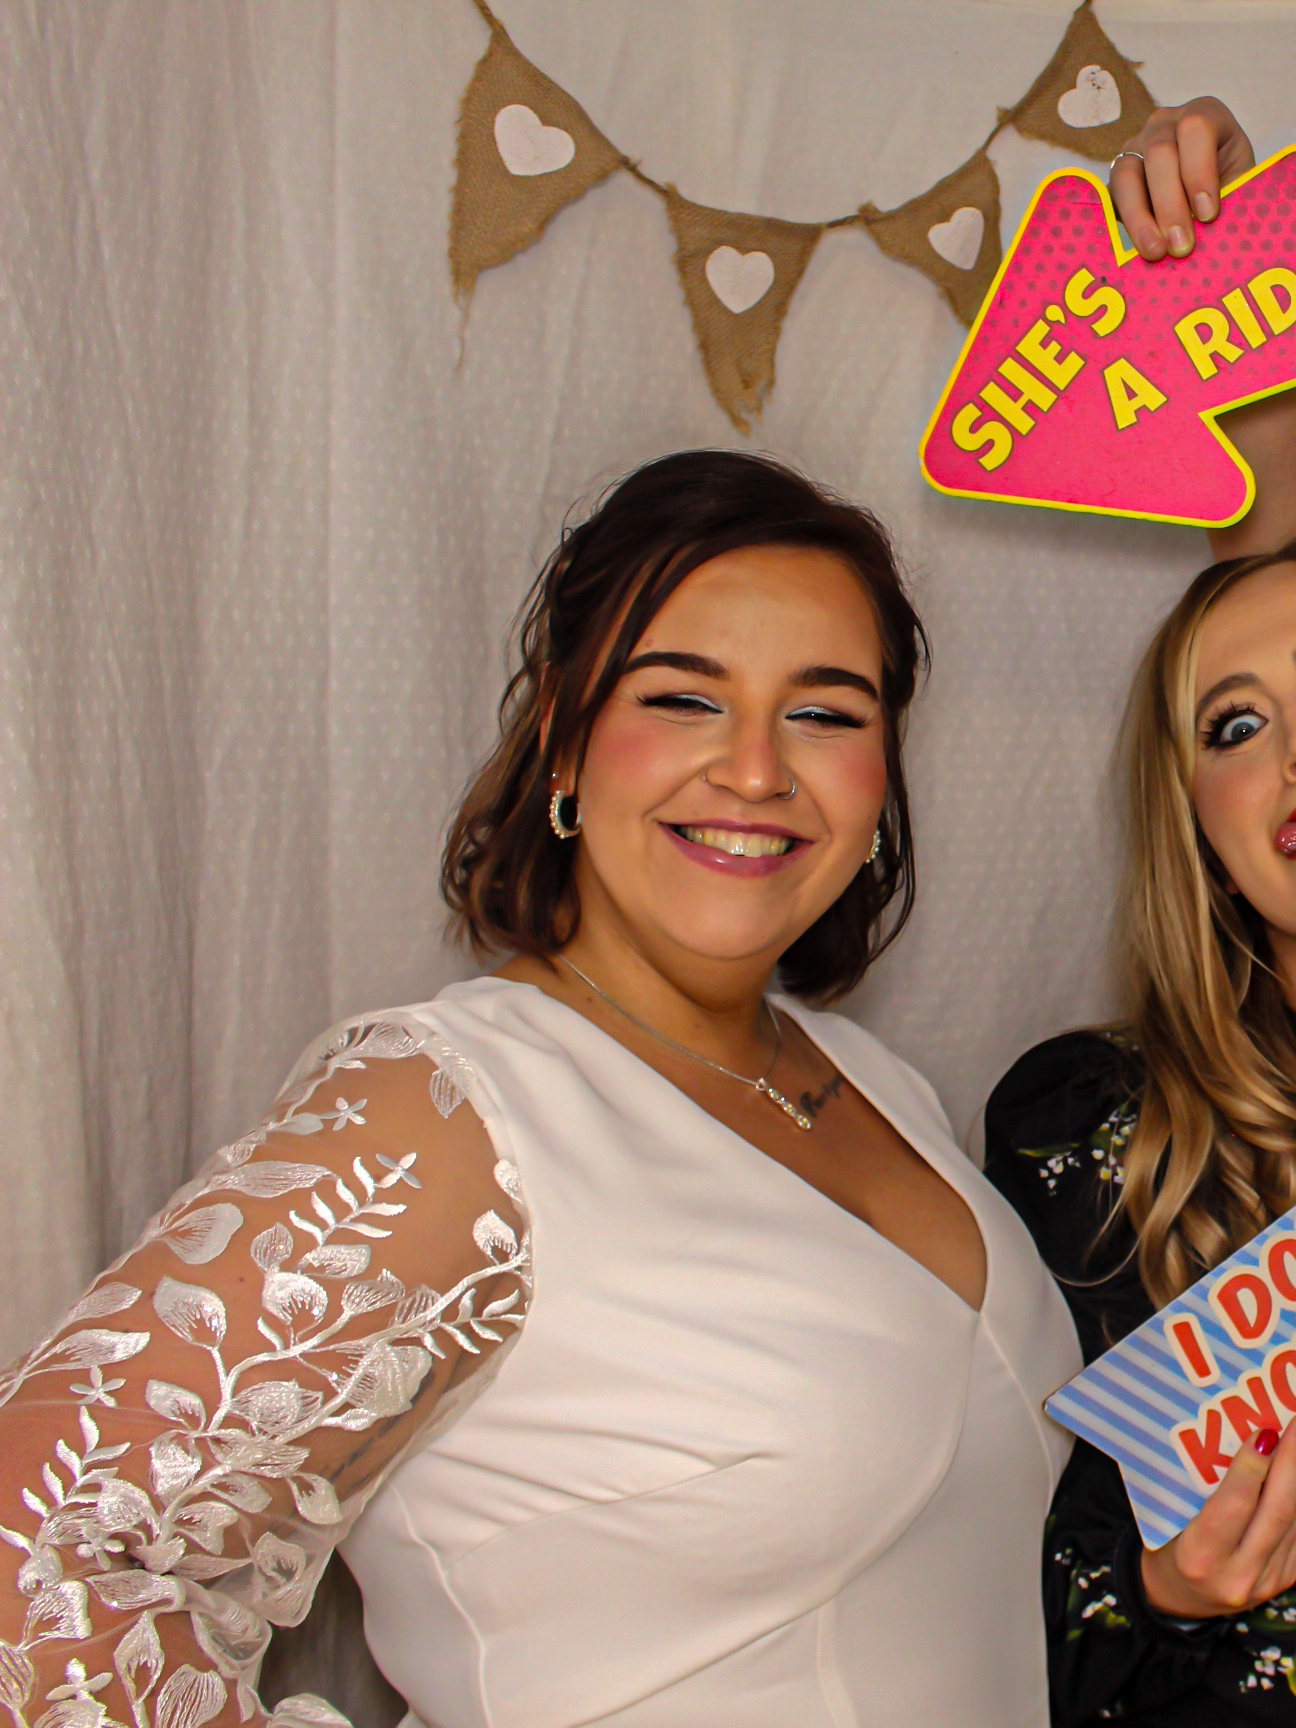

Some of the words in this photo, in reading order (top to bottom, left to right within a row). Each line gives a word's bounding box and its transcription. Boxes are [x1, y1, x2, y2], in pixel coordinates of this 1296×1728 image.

[951, 267, 1127, 472] SHE'S
[1102, 357, 1169, 431] A
[1171, 1320, 1212, 1380] I
